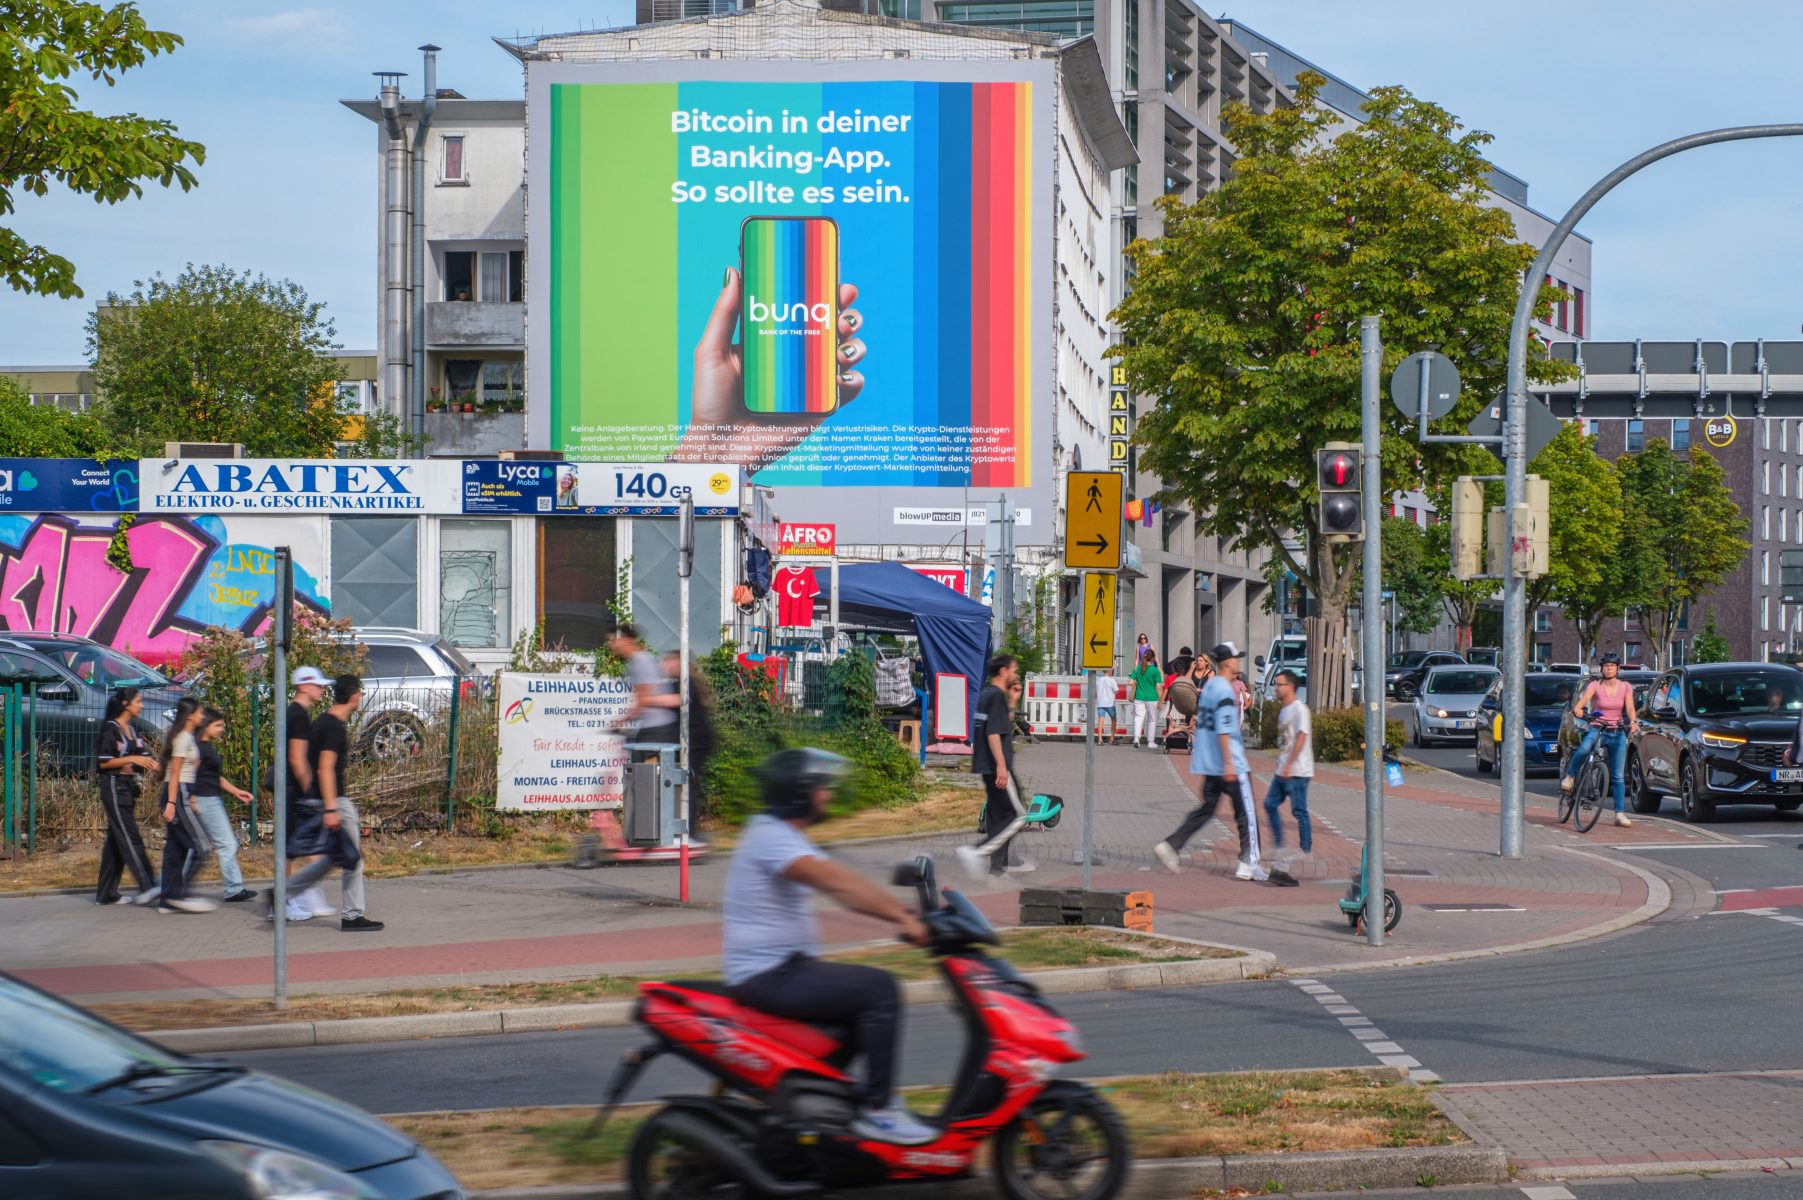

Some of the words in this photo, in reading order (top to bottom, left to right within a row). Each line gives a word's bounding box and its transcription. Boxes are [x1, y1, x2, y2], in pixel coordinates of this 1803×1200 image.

[671, 108, 773, 133] Bitcoin
[782, 109, 808, 133] in
[816, 108, 911, 133] deiner
[691, 144, 891, 174] Banking-App.
[671, 180, 707, 203] So
[714, 180, 794, 204] sollte
[802, 185, 835, 203] es
[842, 178, 910, 203] sein.
[749, 296, 830, 330] bunq
[1111, 367, 1127, 472] HAND
[596, 425, 665, 433] Anlageberatung.
[733, 424, 808, 433] Kryptowährungen
[811, 425, 830, 433] birgt
[892, 424, 906, 432] Die
[908, 425, 1010, 434] Krypto-Dienstleistungen
[1708, 423, 1732, 435] B&B
[581, 434, 612, 442] werden
[631, 434, 667, 442] Payward
[669, 434, 709, 442] European
[895, 434, 952, 443] bereitgestellt,
[564, 444, 616, 452] Zentralbank
[660, 444, 705, 452] genehmigt
[754, 444, 890, 453] Kryptowert-Marketingmitteilung
[965, 445, 1017, 454] zuständigen
[703, 453, 760, 462] Europäischen
[789, 454, 820, 462] geprüft
[842, 454, 891, 462] genehmigt.
[910, 454, 946, 462] Anbieter
[965, 455, 1016, 463] Kryptowerts
[81, 469, 110, 477] Connect
[498, 463, 540, 481] Lyca
[834, 464, 972, 473] Kryptowert-Marketingmitteilung.
[88, 478, 110, 486] World
[615, 472, 667, 498] 140
[243, 497, 257, 508] u.
[260, 495, 424, 509] GESCHENKARTIKEL
[899, 511, 932, 520] blowUP
[933, 512, 961, 521] media
[782, 545, 832, 555] Lebensmittel
[528, 680, 595, 693] LEIHHAUS
[578, 697, 628, 705] PFANDKREDIT
[544, 707, 601, 715] BRÜCKSTRASSE
[603, 707, 612, 715] 56
[567, 720, 585, 728] TEL.:
[533, 738, 552, 751] Fair
[555, 738, 584, 751] Kredit
[1779, 770, 1790, 779] NR
[514, 777, 558, 786] MONTAG
[566, 776, 605, 786] FREITAG
